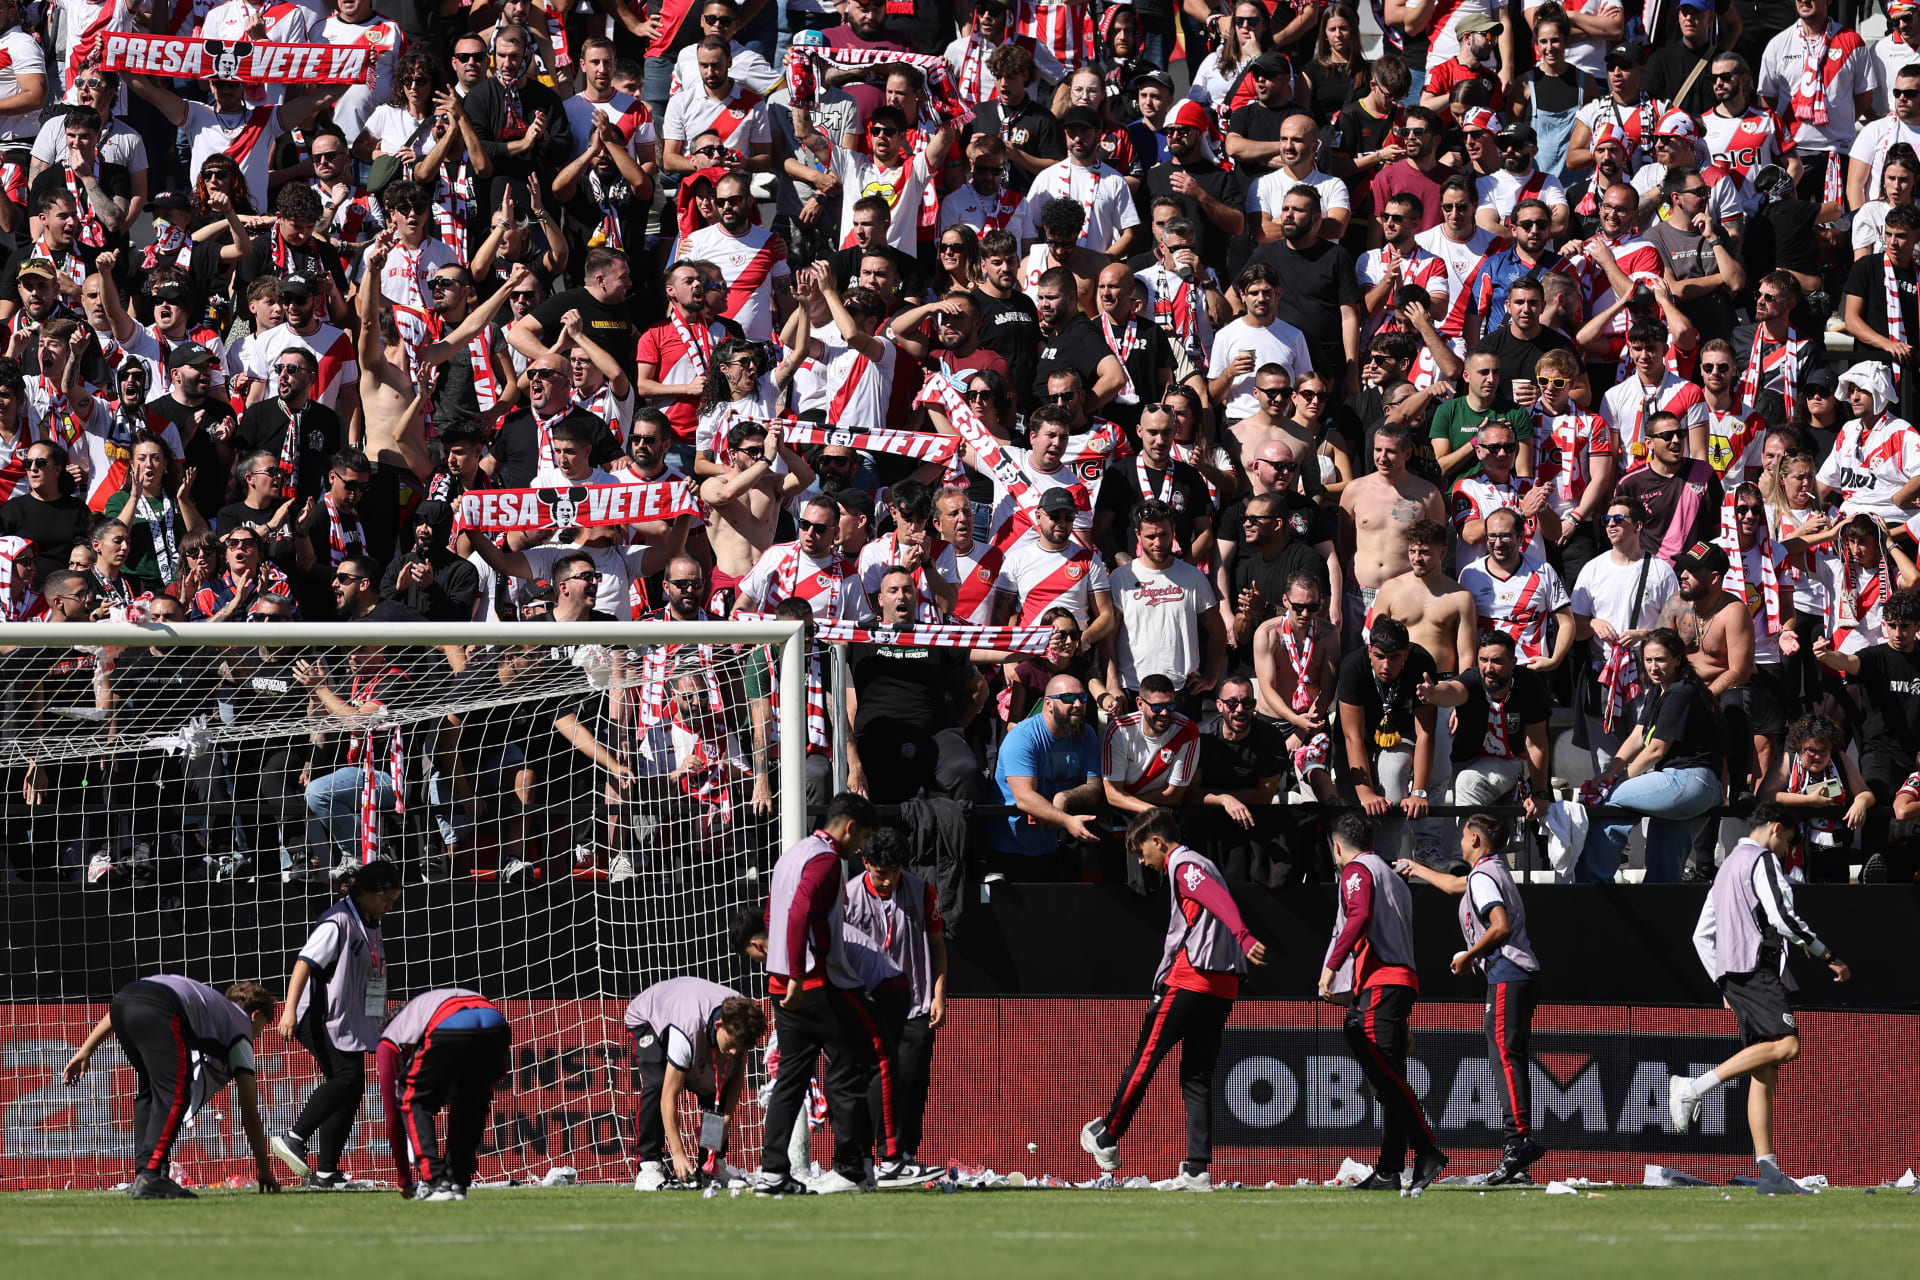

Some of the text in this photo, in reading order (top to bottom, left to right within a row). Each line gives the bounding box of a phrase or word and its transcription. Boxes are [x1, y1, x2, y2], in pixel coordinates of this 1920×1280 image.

[105, 35, 367, 79] PRESA VETE YA
[787, 110, 843, 131] リオ
[1011, 128, 1026, 143] 161
[866, 428, 952, 464] VETE
[462, 481, 700, 527] RESA VETE YA
[912, 625, 1054, 655] VETE YA
